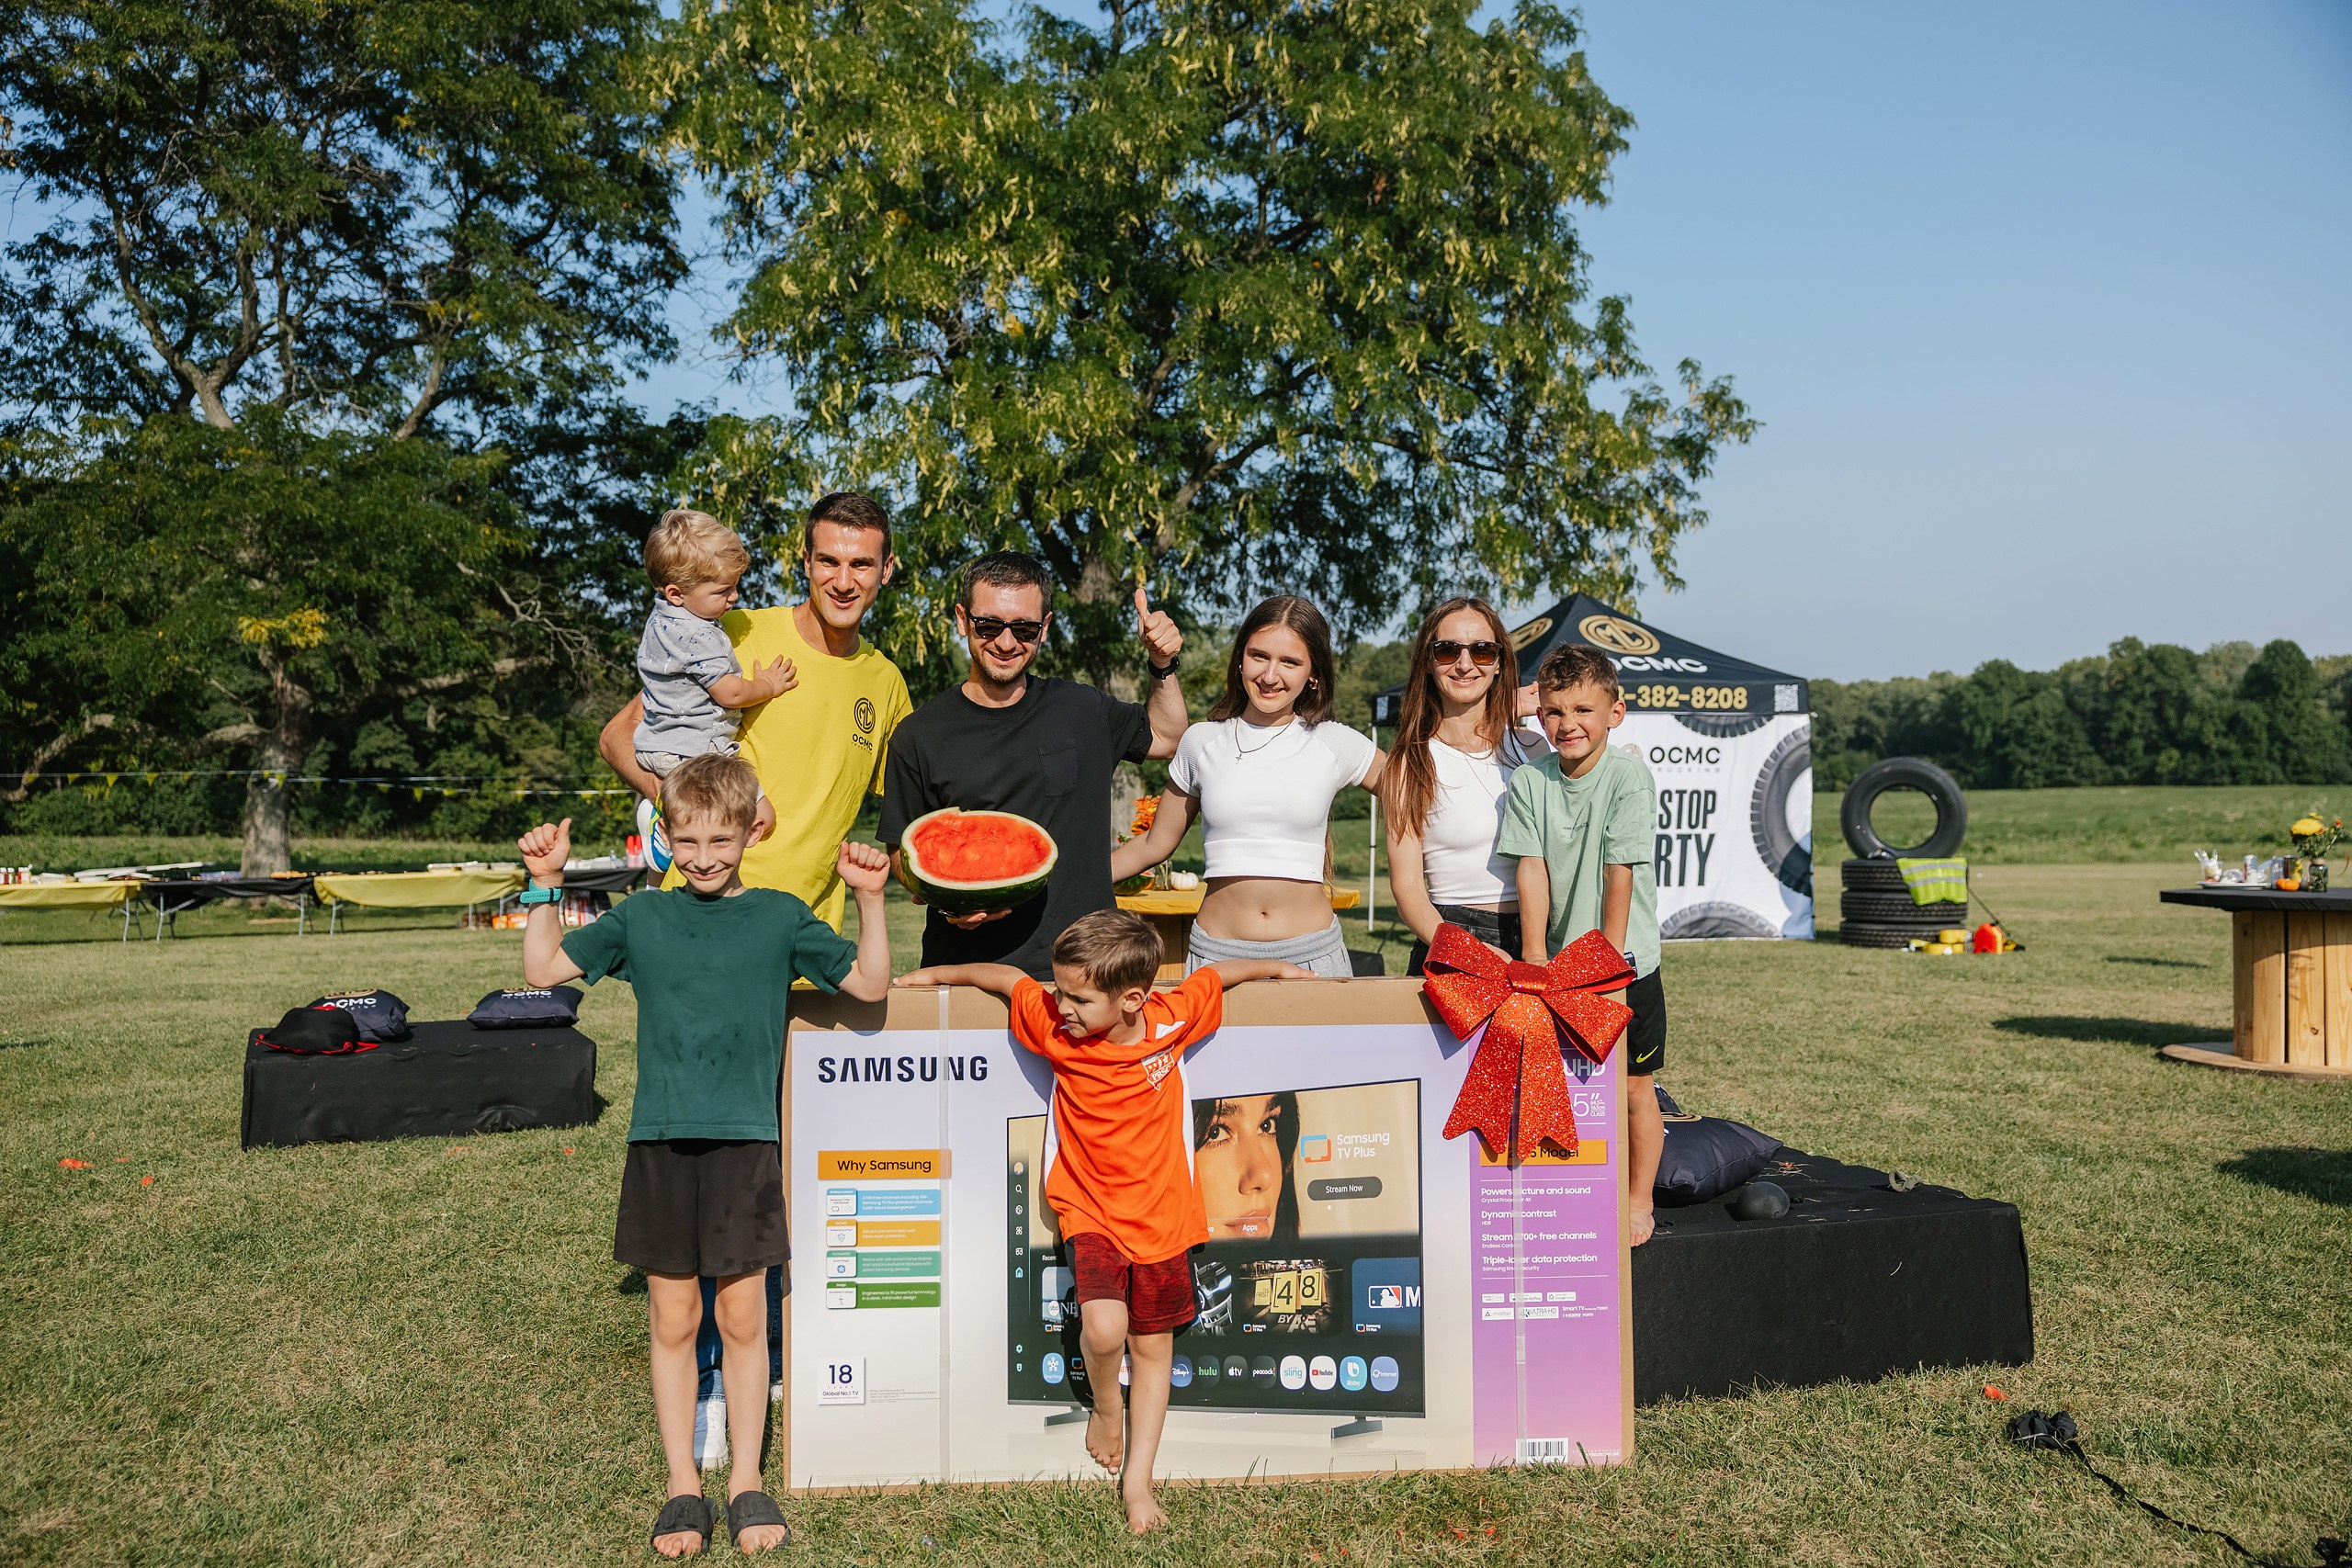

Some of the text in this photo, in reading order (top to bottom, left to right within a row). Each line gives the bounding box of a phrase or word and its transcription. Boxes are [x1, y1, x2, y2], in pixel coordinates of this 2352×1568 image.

[852, 733, 873, 751] OCMC
[1650, 747, 1721, 764] OCMC
[1658, 789, 1717, 829] STOP
[818, 1056, 988, 1084] SAMSUNG
[1337, 1132, 1390, 1145] Samsung
[1338, 1146, 1376, 1159] TV Plus
[837, 1160, 932, 1174] Why Samsung
[1325, 1184, 1363, 1193] Stream Now
[1481, 1188, 1513, 1196] Powers
[1546, 1187, 1564, 1195] and
[1565, 1186, 1591, 1194] sound
[1521, 1209, 1557, 1218] contrast
[1242, 1224, 1258, 1232] Apps
[1481, 1233, 1513, 1241] Stream
[1539, 1232, 1557, 1240] free
[1558, 1232, 1598, 1240] channels
[1532, 1255, 1553, 1263] data
[1554, 1254, 1598, 1265] protection
[1278, 1314, 1294, 1324] BY
[829, 1364, 853, 1384] 18
[1198, 1366, 1217, 1376] hulu
[1252, 1368, 1274, 1377] peacock
[1283, 1368, 1303, 1378] sling
[1346, 1380, 1361, 1388] Bixby
